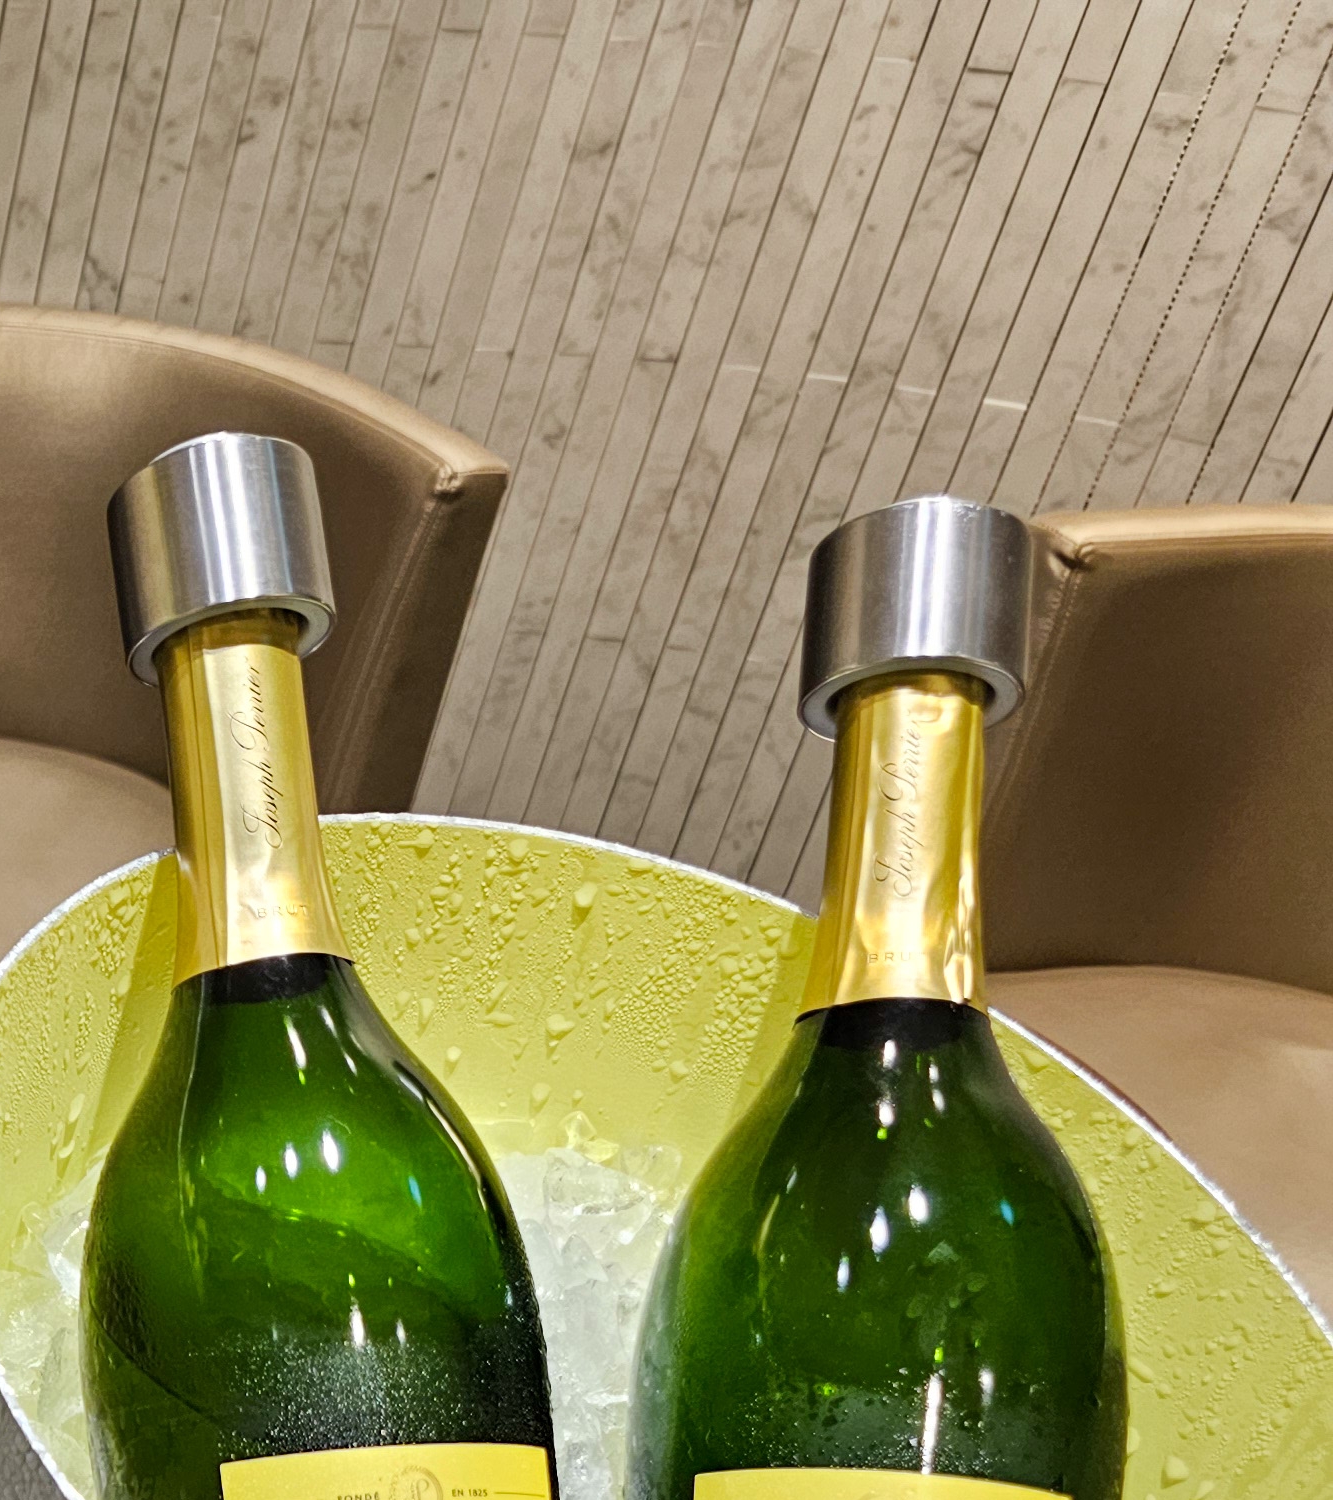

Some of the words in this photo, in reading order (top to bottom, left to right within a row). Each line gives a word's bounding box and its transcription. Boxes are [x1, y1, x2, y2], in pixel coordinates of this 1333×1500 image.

[256, 903, 310, 919] BRUT
[867, 951, 925, 964] BRU
[452, 1488, 465, 1498] EN
[469, 1488, 488, 1498] 1825
